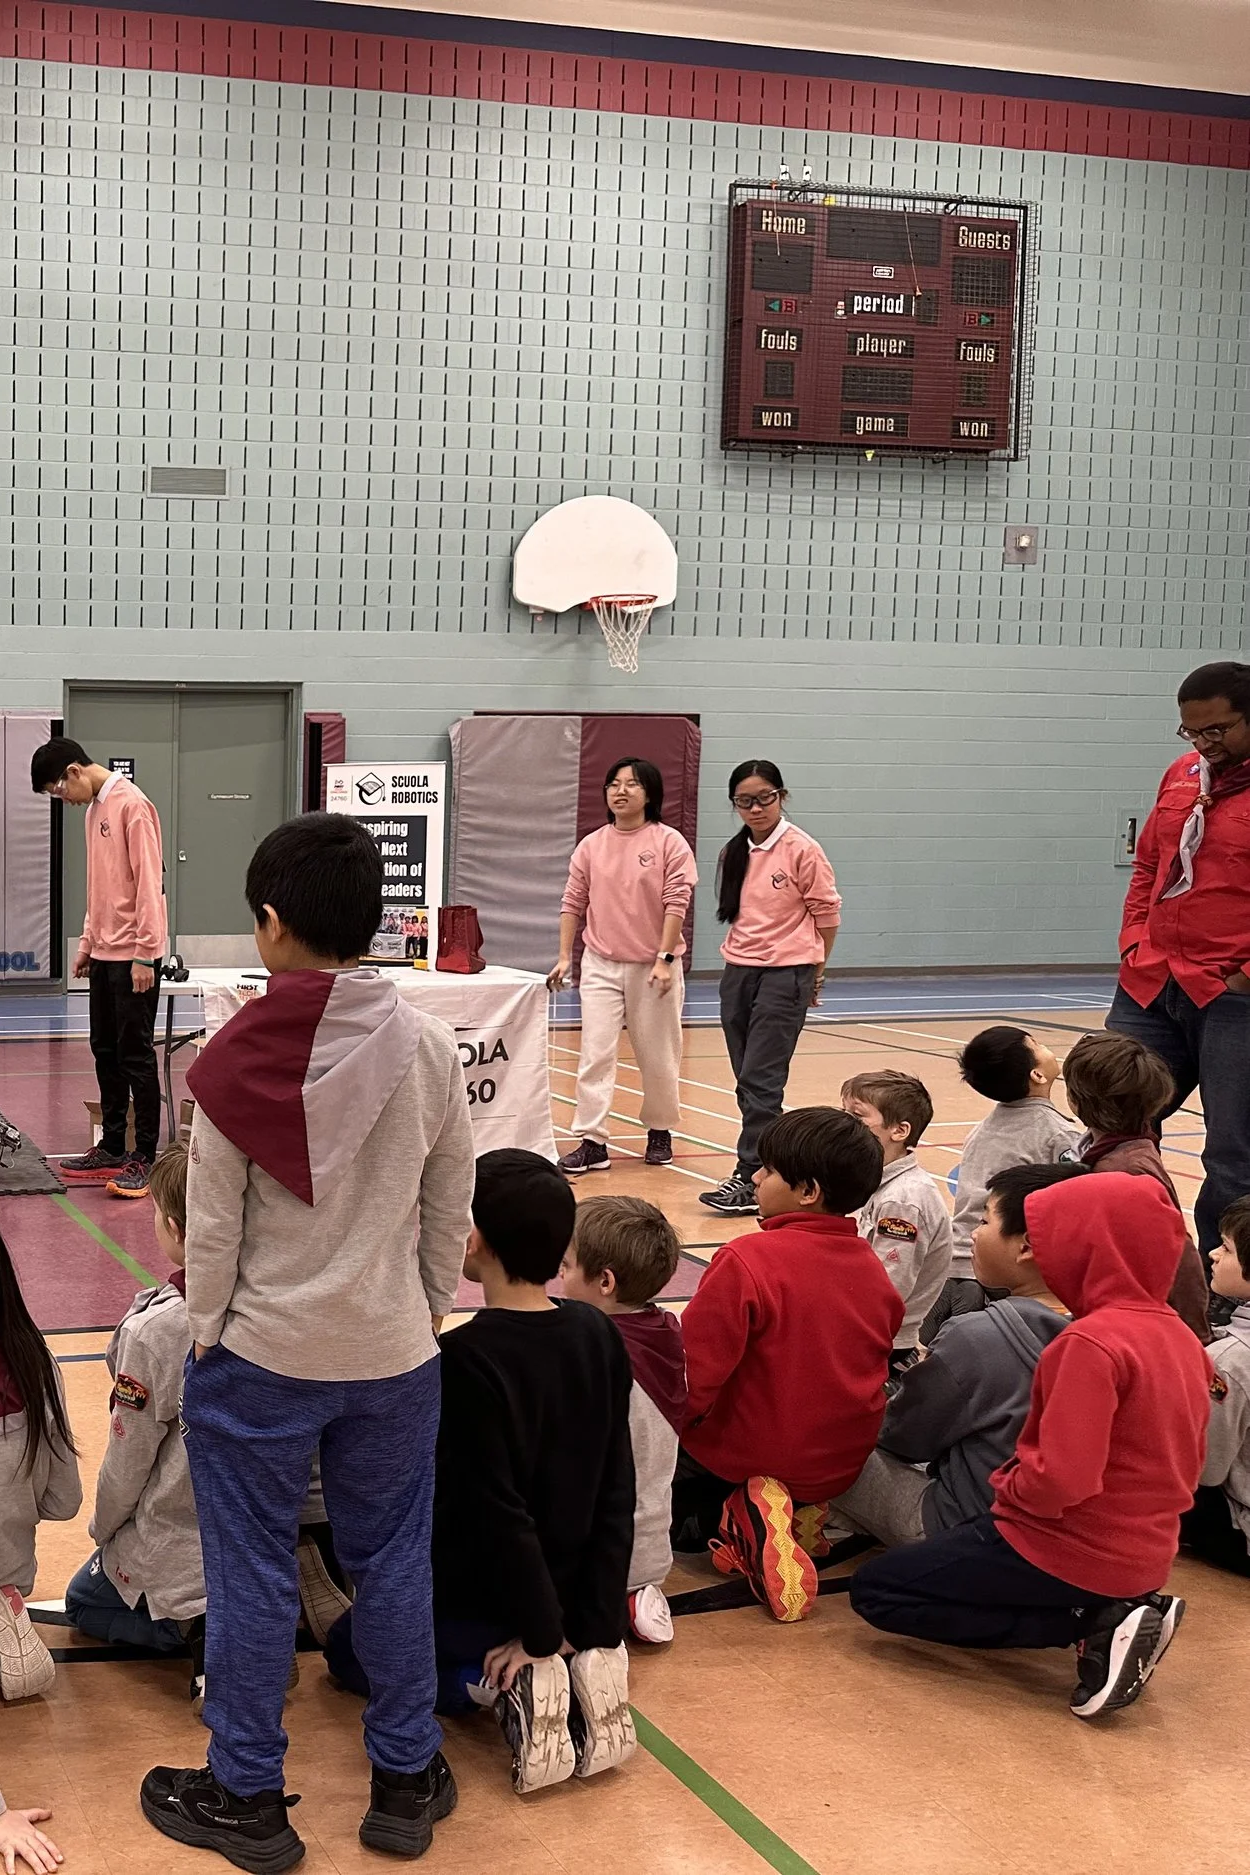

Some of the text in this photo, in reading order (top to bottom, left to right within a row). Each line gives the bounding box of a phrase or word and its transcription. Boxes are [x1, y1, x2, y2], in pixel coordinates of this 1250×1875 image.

[762, 210, 806, 235] Home
[958, 226, 1011, 251] Guests
[853, 294, 904, 315] period
[761, 328, 798, 351] fouls
[856, 333, 906, 357] player
[960, 342, 995, 364] fouls
[761, 409, 791, 427] won
[856, 415, 894, 434] game
[960, 420, 988, 438] won
[391, 775, 428, 787] SCUOLA
[391, 791, 438, 804] ROBOTICS
[357, 821, 408, 837] spiring
[381, 842, 408, 856] Next
[384, 862, 423, 877] tion of
[381, 883, 423, 897] eaders
[457, 1038, 509, 1068] OLA
[466, 1078, 496, 1106] 60
